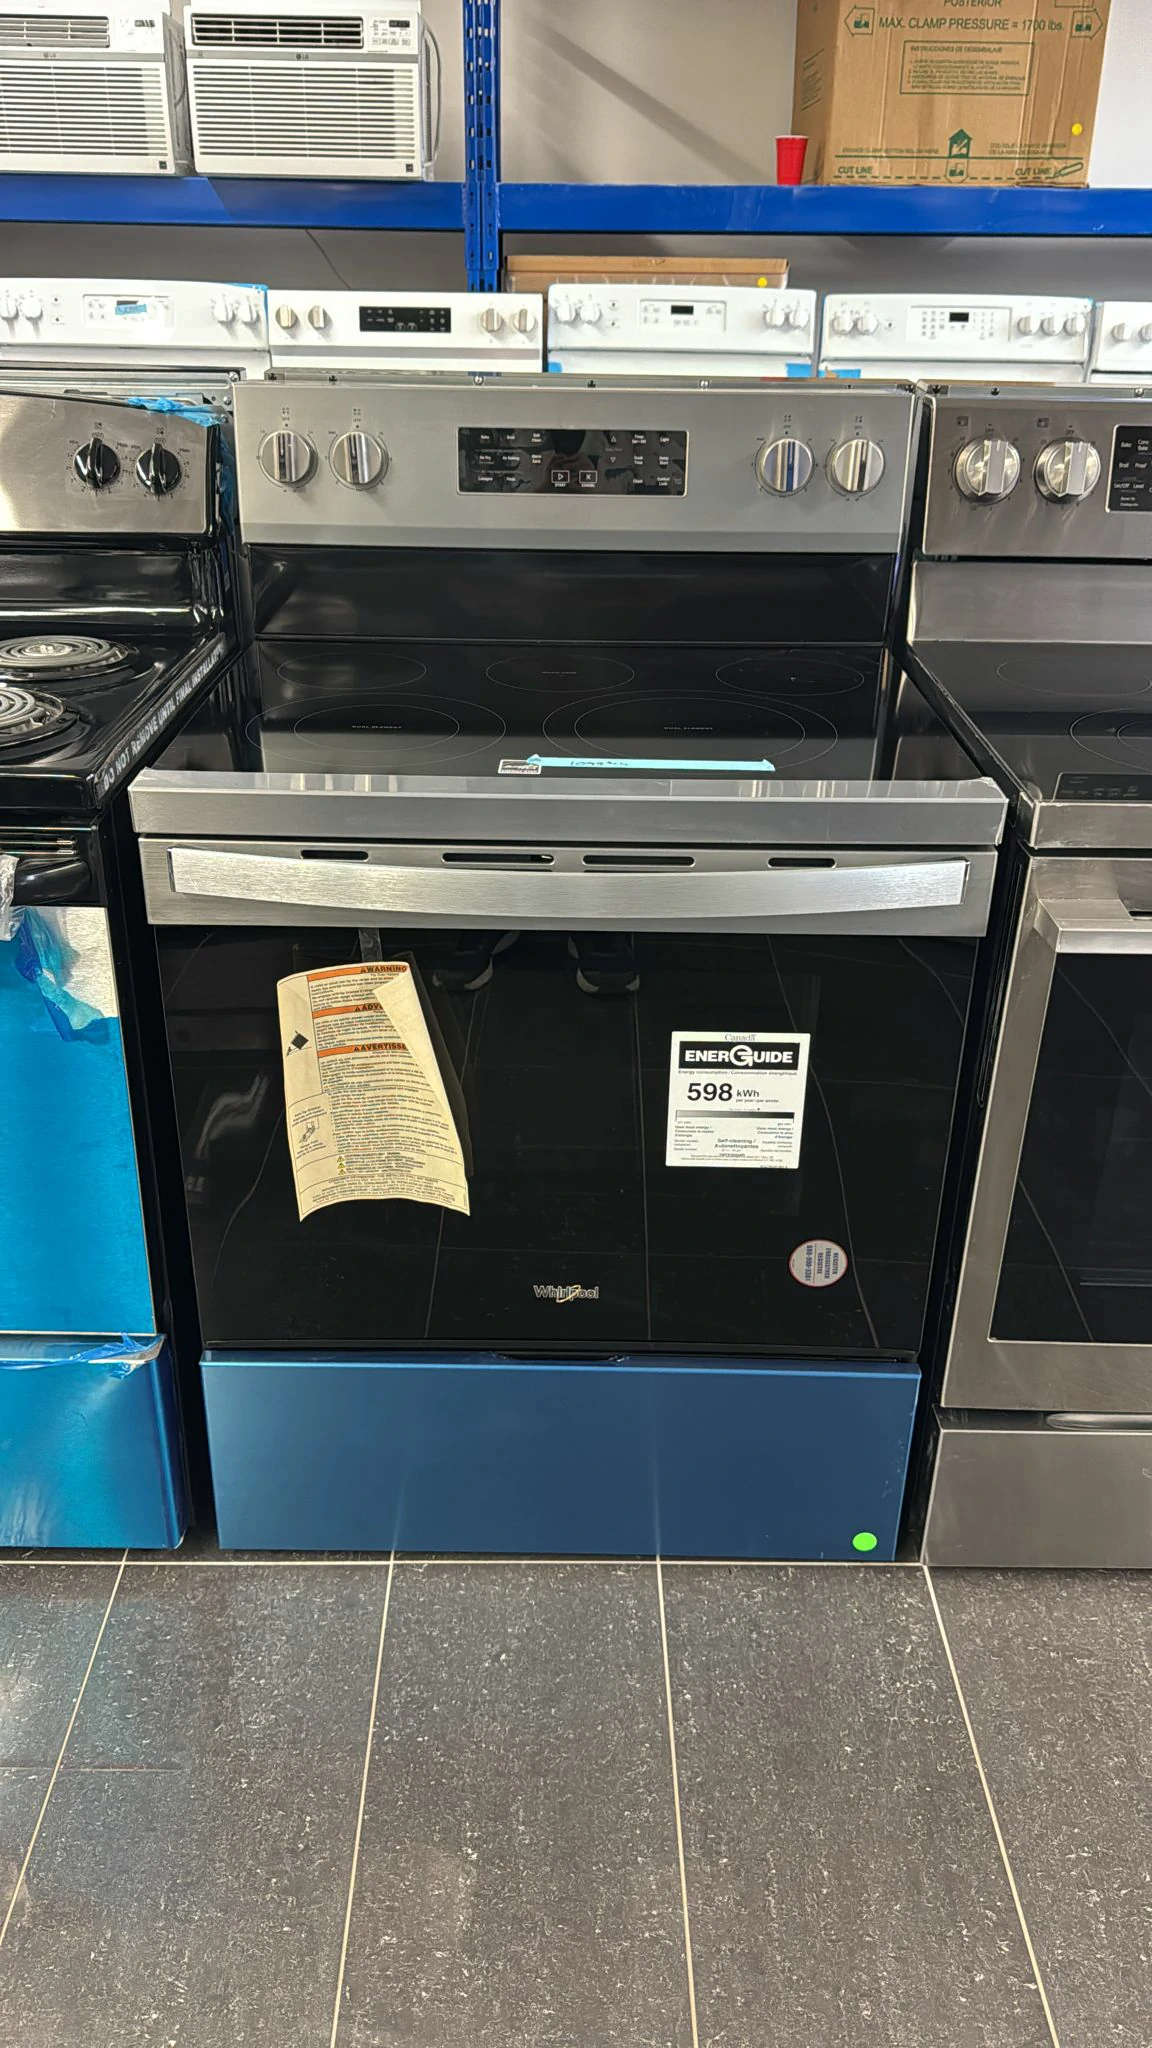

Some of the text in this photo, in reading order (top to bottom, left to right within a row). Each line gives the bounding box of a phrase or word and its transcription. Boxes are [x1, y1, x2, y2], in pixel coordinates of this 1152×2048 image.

[879, 17, 904, 29] MAX.
[908, 17, 947, 29] CLAMP
[949, 18, 1010, 30] PRESSURE
[1022, 20, 1046, 31] 1700
[1048, 20, 1064, 31] lbs.
[838, 166, 873, 175] CUT LINE
[1015, 168, 1031, 176] CUT
[102, 769, 116, 792] DO
[115, 750, 130, 775] NOT
[157, 703, 176, 727] UNTIL
[175, 683, 193, 708] FINAL
[685, 1045, 793, 1067] ENERGUIDE
[687, 1082, 760, 1101] 598 kWh
[533, 1285, 600, 1303] Whirlpool
